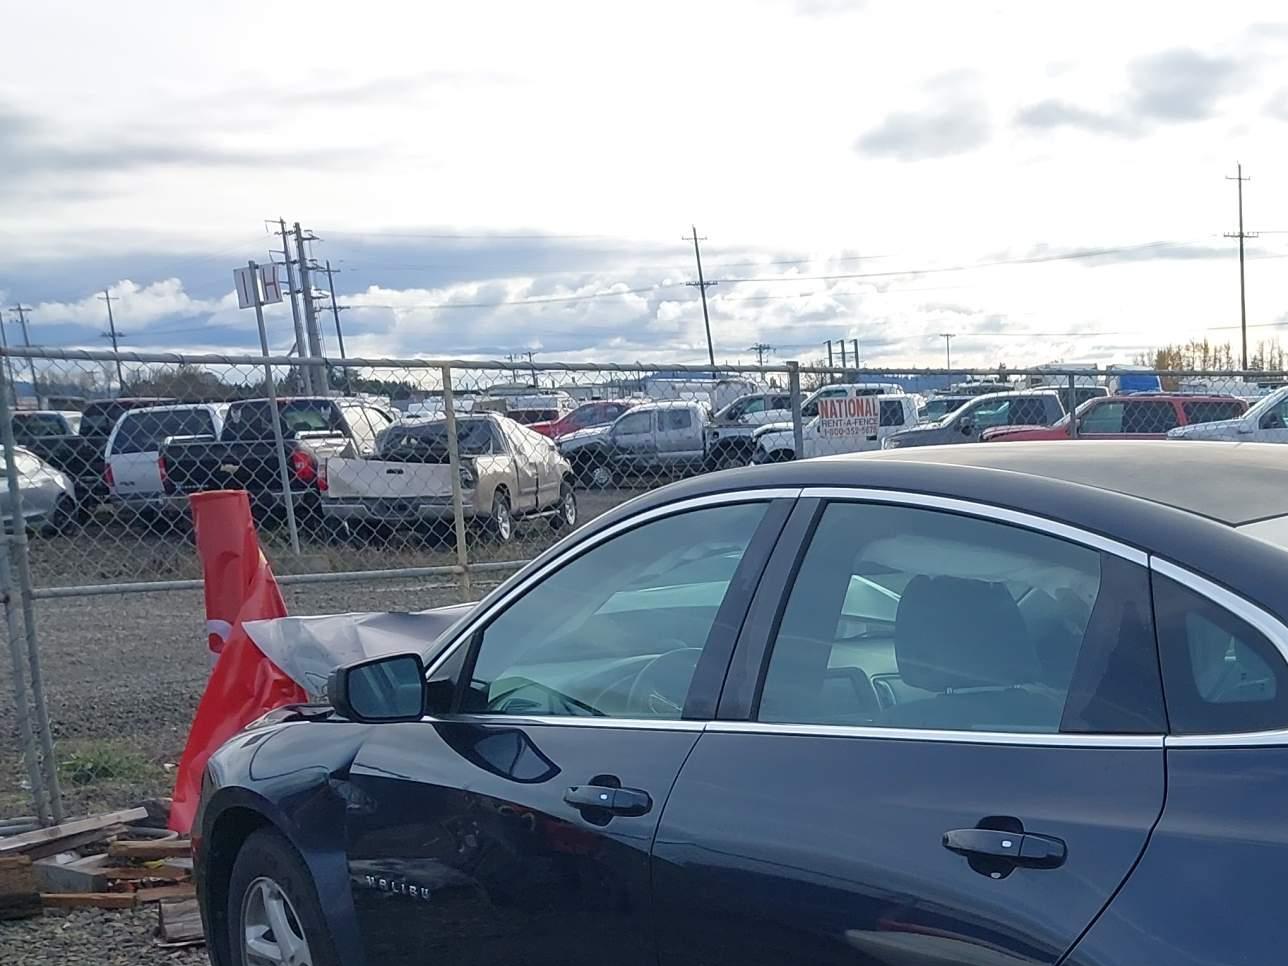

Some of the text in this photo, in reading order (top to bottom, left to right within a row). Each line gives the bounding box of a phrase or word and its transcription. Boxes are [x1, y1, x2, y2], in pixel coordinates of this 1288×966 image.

[262, 266, 279, 301] H
[819, 398, 878, 418] NATIONAL
[365, 875, 430, 899] MALIBU
